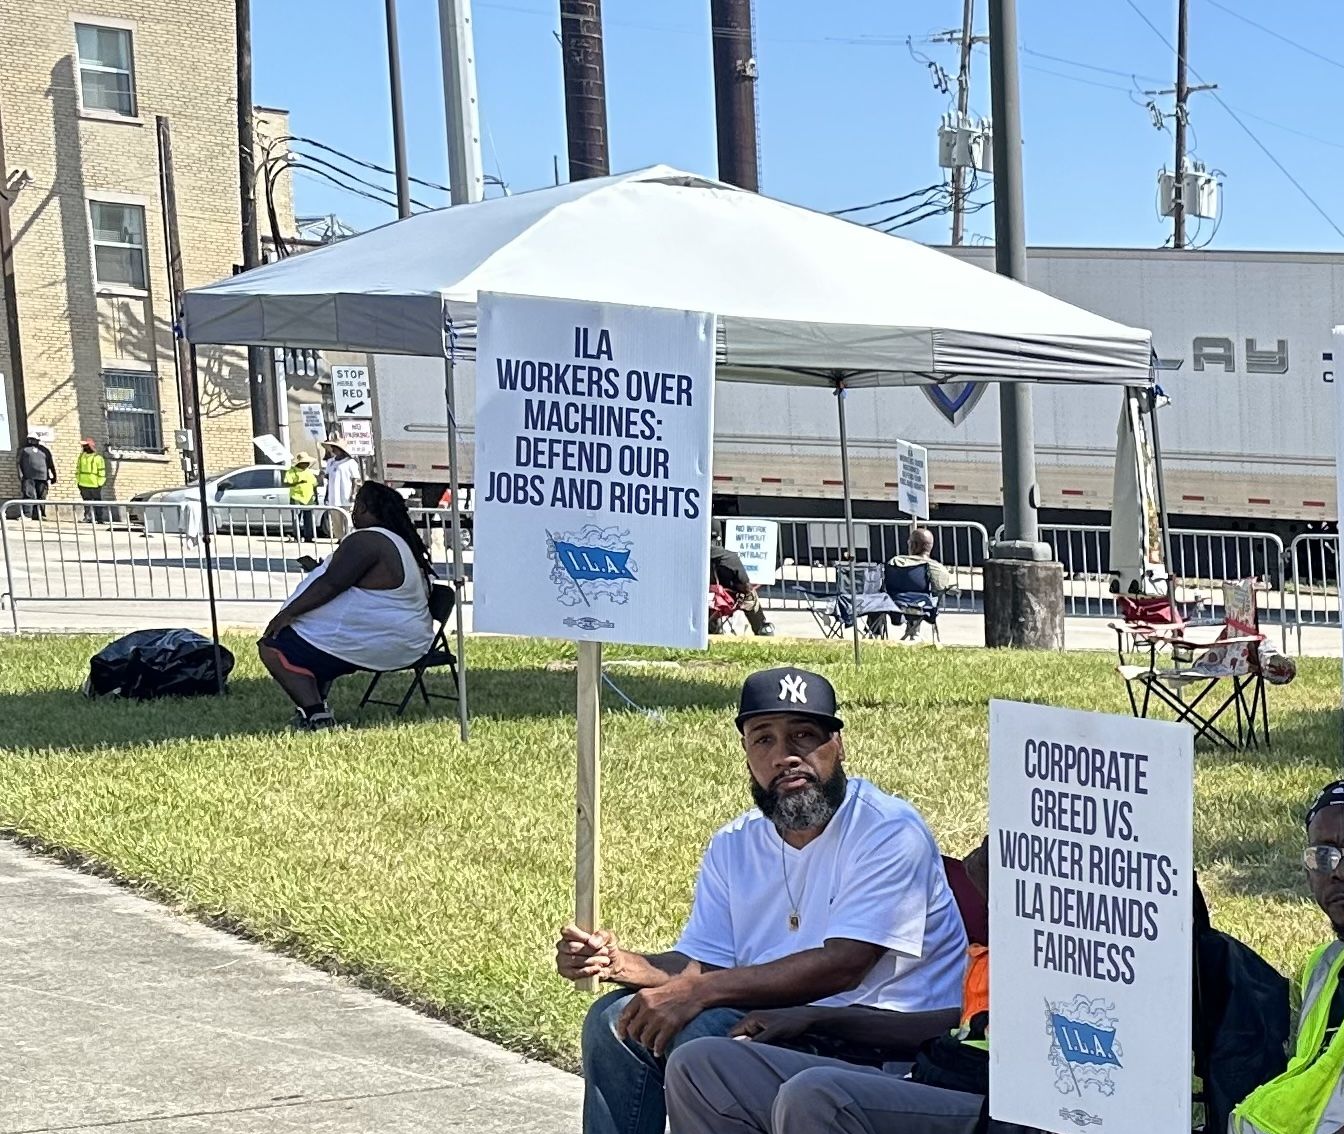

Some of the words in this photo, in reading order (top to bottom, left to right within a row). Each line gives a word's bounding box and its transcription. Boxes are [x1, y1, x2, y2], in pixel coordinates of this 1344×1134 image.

[575, 327, 613, 361] ILA
[336, 370, 365, 379] STOP
[342, 389, 363, 398] RED
[496, 358, 619, 400] WORKERS
[627, 371, 693, 407] OVER
[524, 399, 663, 441] MACHINES:
[516, 436, 611, 474] DEFEND
[619, 445, 669, 479] OUR
[485, 472, 545, 506] JOBS
[550, 476, 602, 510] AND
[610, 482, 700, 519] RIGHTS
[572, 551, 625, 575] I.L.A.
[779, 674, 807, 704] NY
[1025, 739, 1149, 795] CORPORATE
[1031, 788, 1097, 835] GREED
[1103, 799, 1139, 842] VS.
[999, 829, 1083, 882] WORKER
[1090, 844, 1178, 897] RIGHTS:
[1015, 879, 1044, 921] ILA
[1050, 886, 1158, 941] DEMANDS
[1033, 930, 1135, 985] FAIRNESS
[1062, 1026, 1112, 1060] I.L.A.
